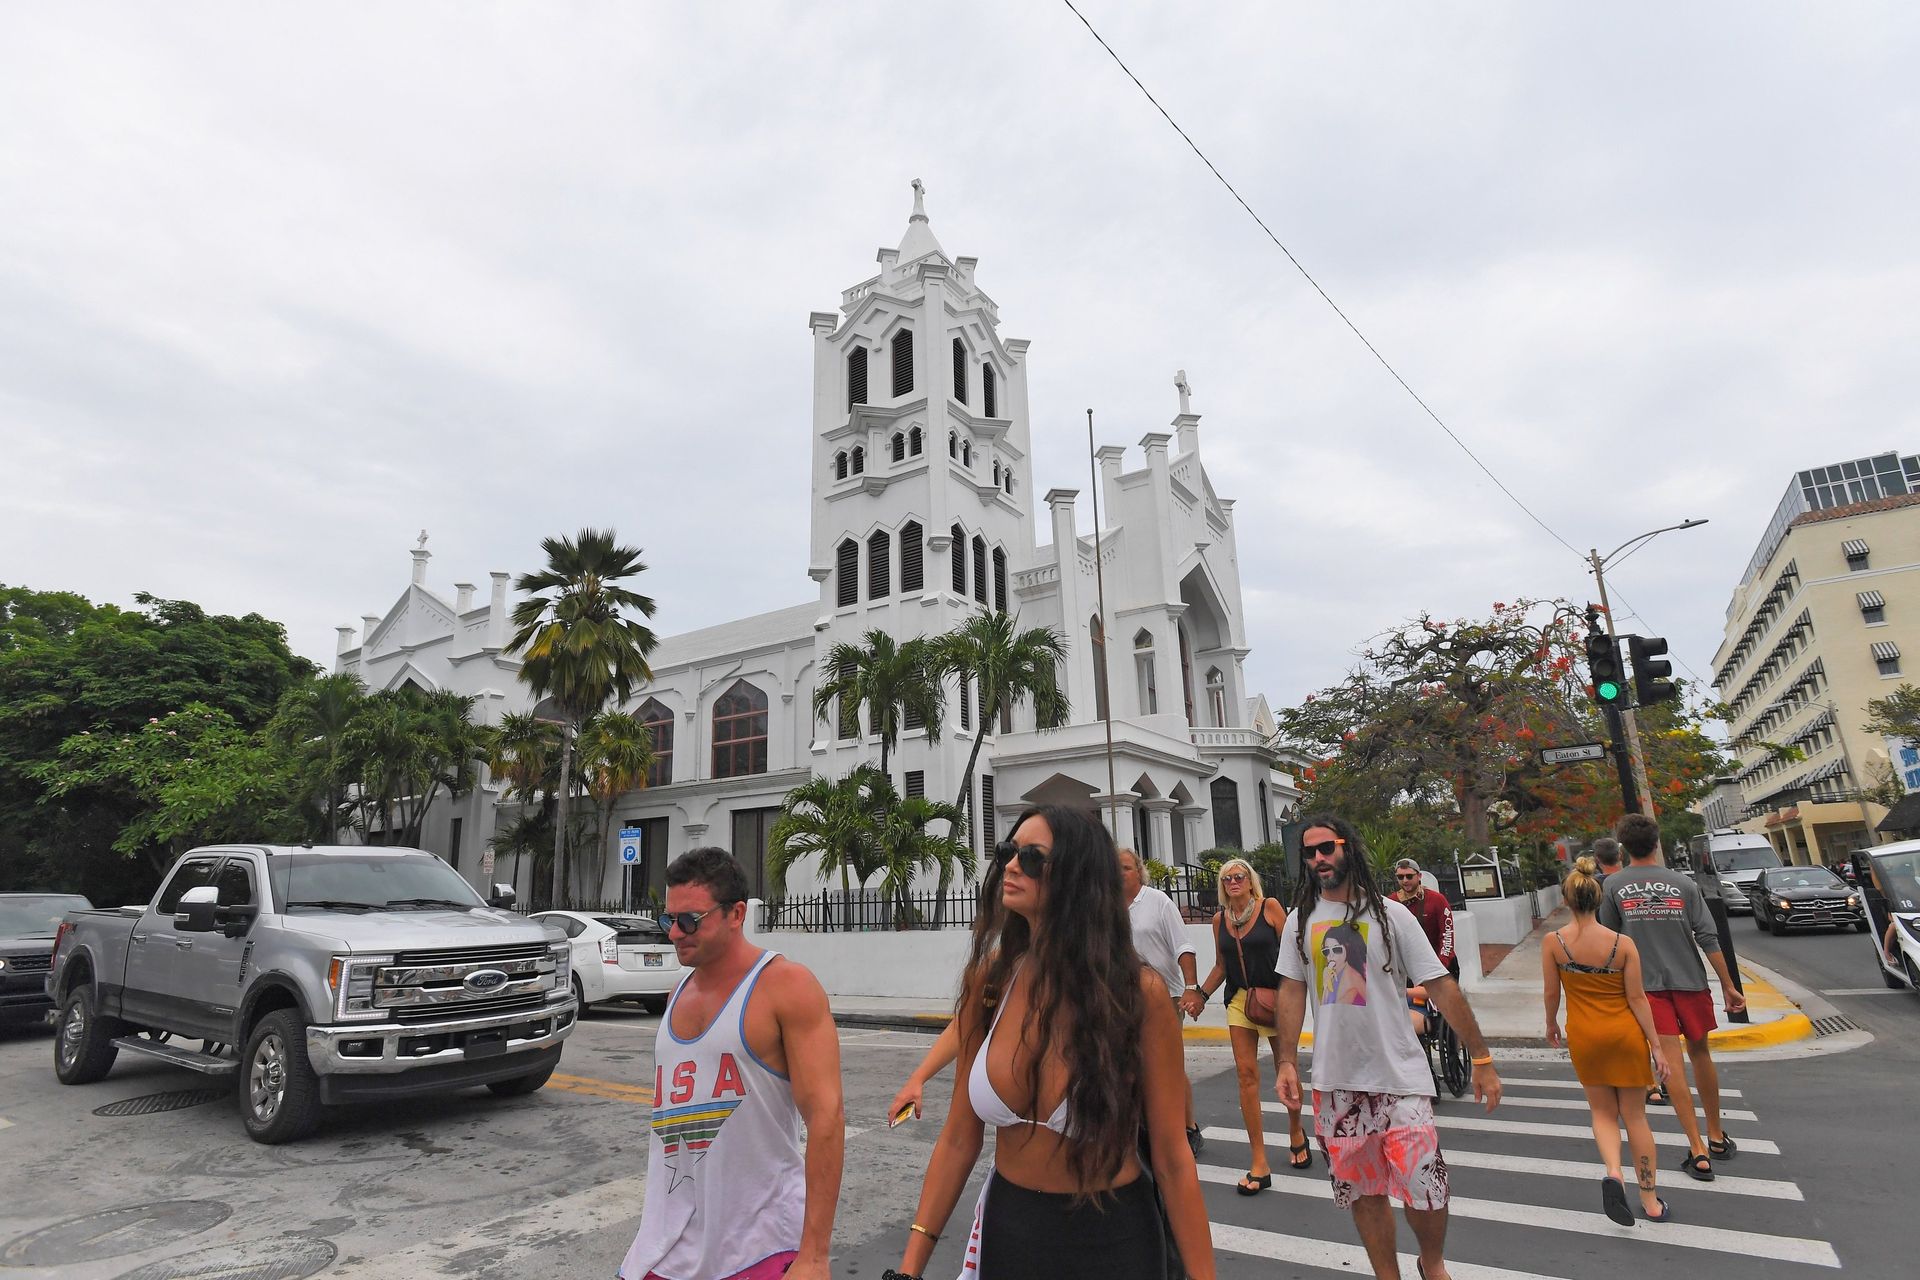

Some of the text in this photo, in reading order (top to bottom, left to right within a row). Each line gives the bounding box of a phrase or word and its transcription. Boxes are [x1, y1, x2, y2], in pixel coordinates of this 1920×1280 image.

[1555, 748, 1591, 759] Eaton St
[626, 848, 634, 859] P
[1617, 881, 1681, 899] PELAGIC
[1900, 899, 1913, 908] 18
[1650, 908, 1683, 916] COMPANY
[1443, 917, 1454, 957] Columbia
[476, 974, 499, 986] Ford
